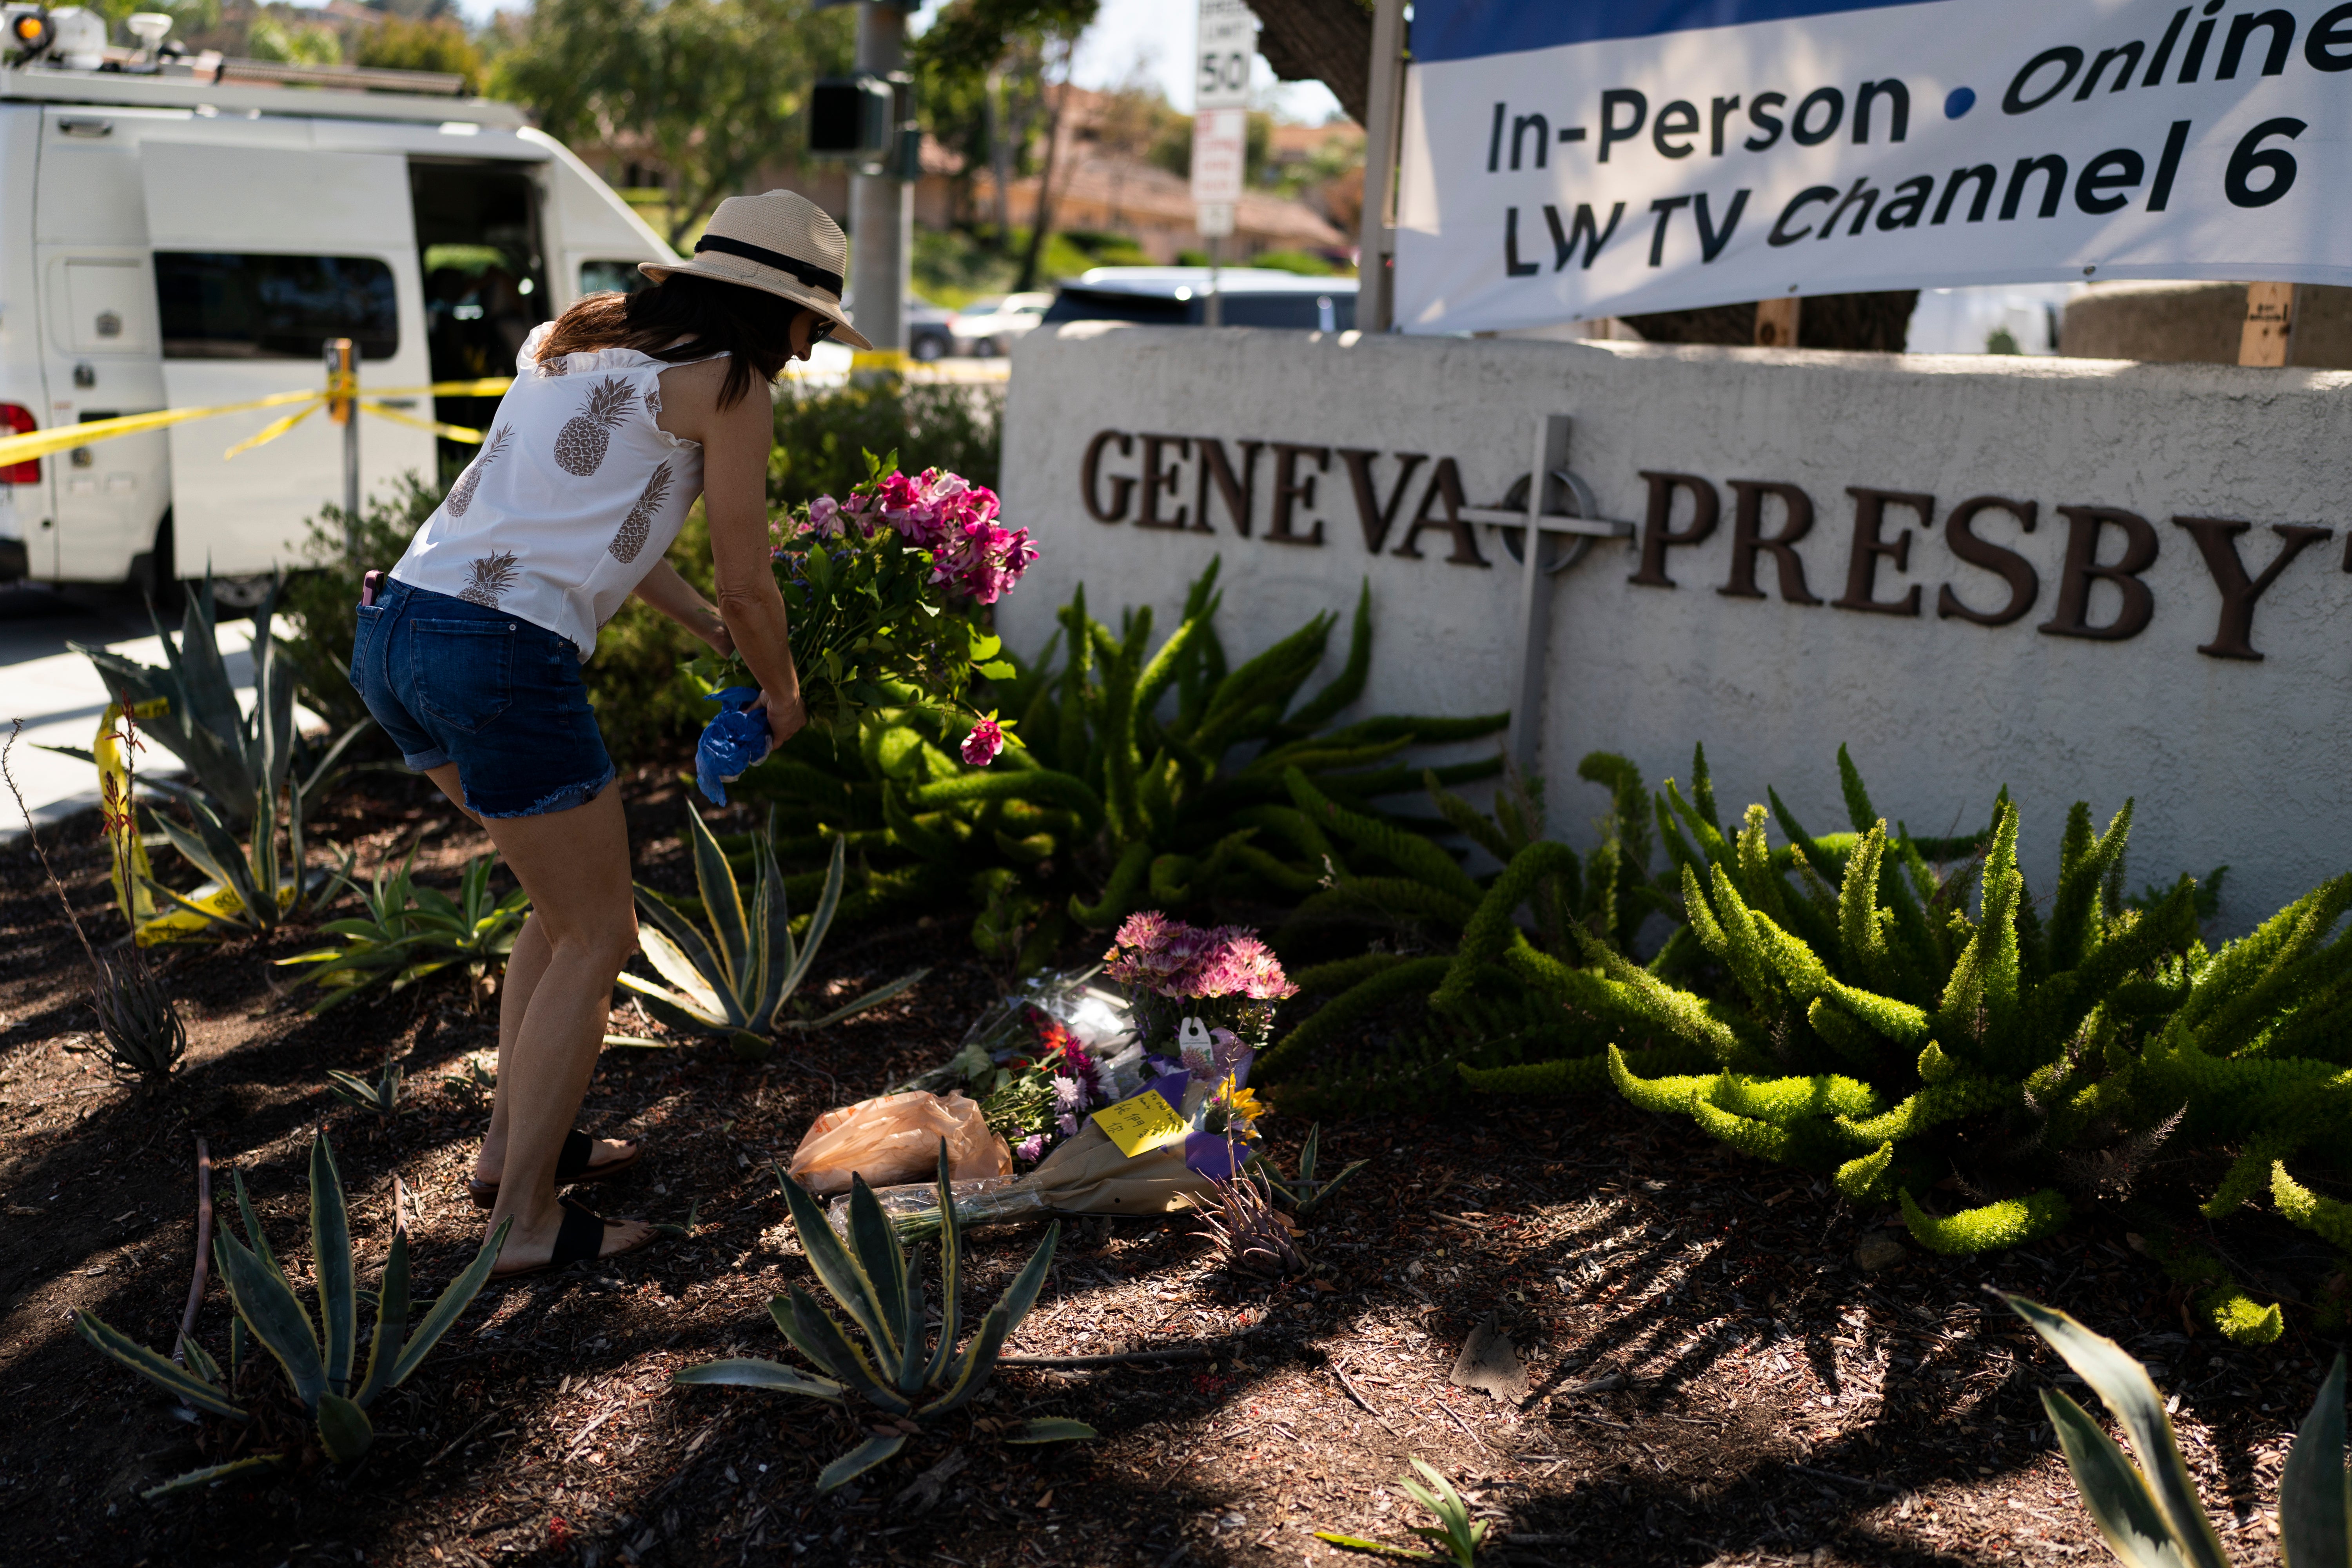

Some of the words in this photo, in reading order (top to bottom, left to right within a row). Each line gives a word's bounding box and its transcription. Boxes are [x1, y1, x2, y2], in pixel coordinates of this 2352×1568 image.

[1201, 52, 1245, 93] 50
[1487, 78, 1910, 172] In-Person
[2001, 0, 2352, 116] Online
[1504, 202, 1625, 278] LW
[1649, 189, 1751, 267] TV
[1767, 119, 2192, 248] Channel
[2224, 116, 2308, 209] 6
[1083, 430, 1493, 570] GENEVA
[1629, 470, 2352, 665] PRESBY
[1106, 1123, 1124, 1134] 你
[1156, 1102, 1166, 1111] our
